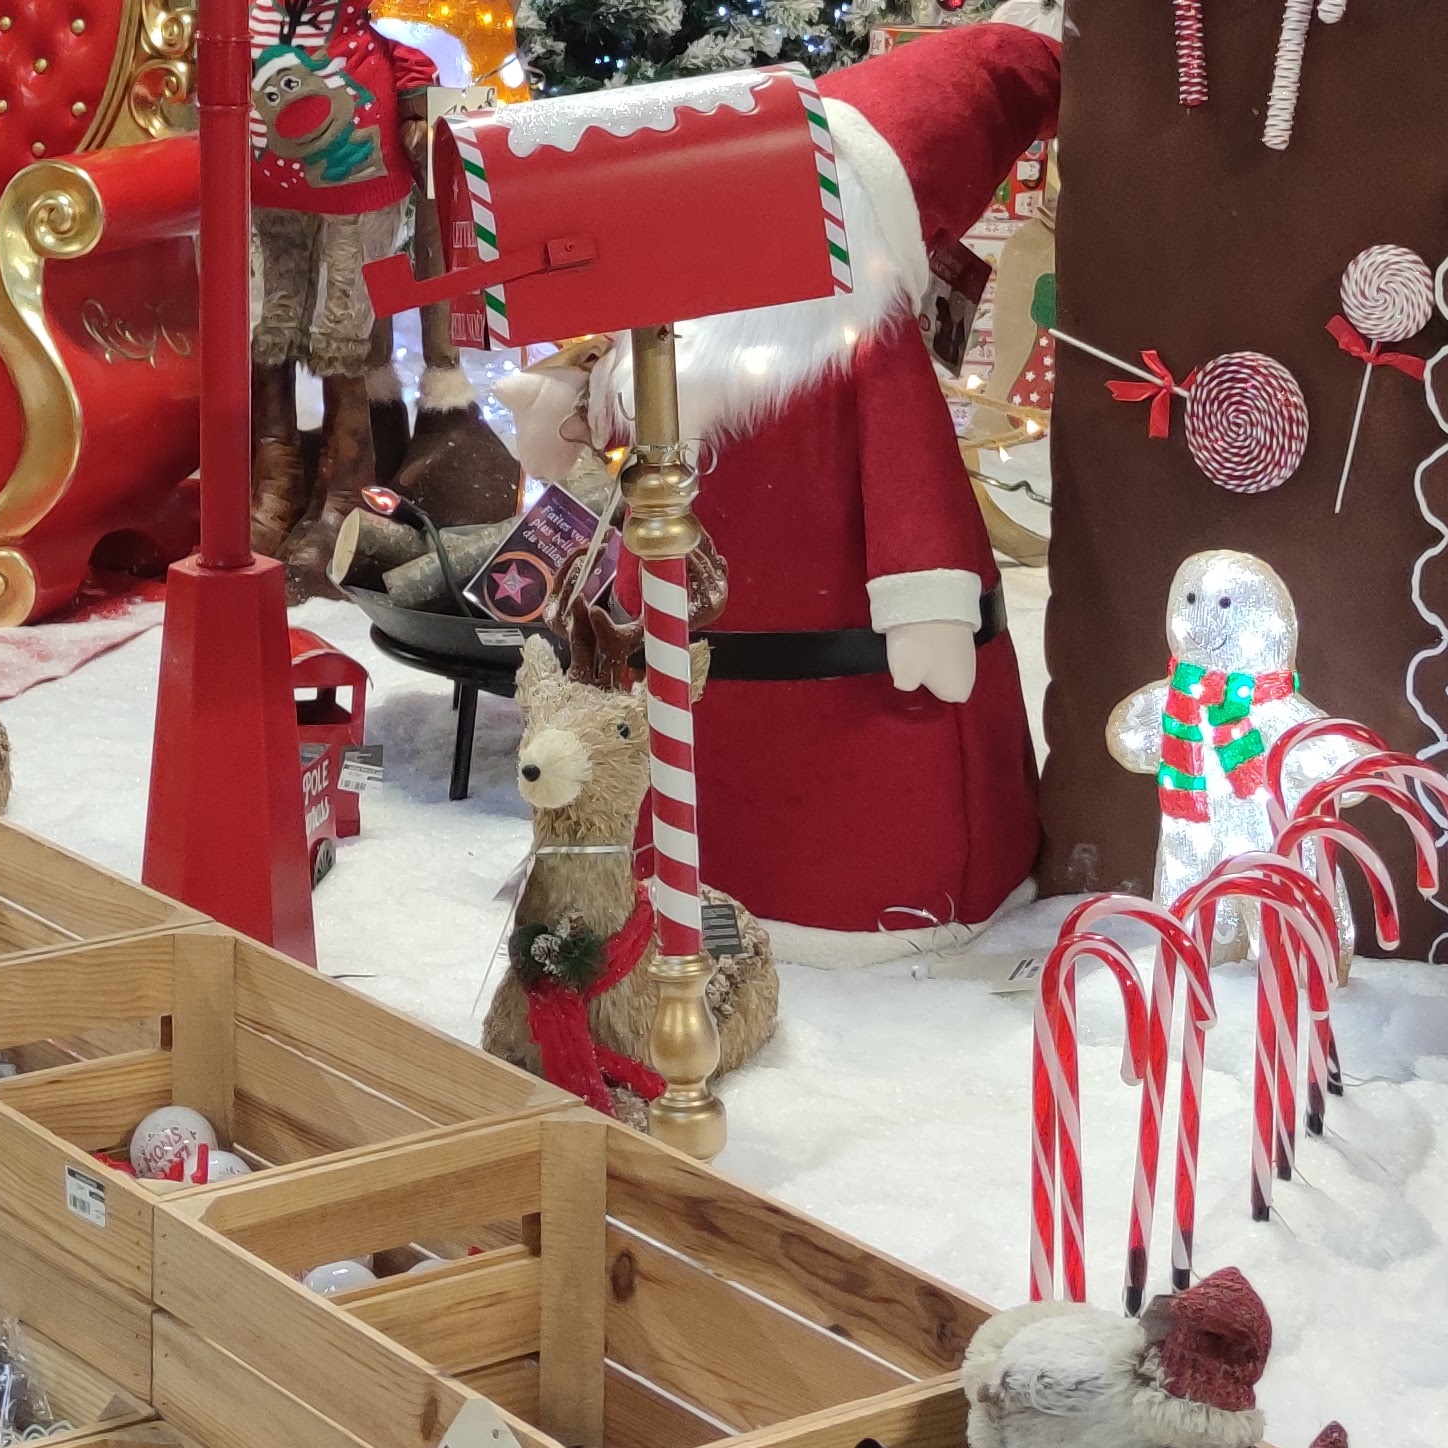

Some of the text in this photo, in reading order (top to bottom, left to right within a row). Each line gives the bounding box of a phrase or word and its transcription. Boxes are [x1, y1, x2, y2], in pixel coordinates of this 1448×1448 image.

[528, 517, 552, 537] plus
[540, 504, 571, 532] Faites
[522, 529, 564, 567] du villag
